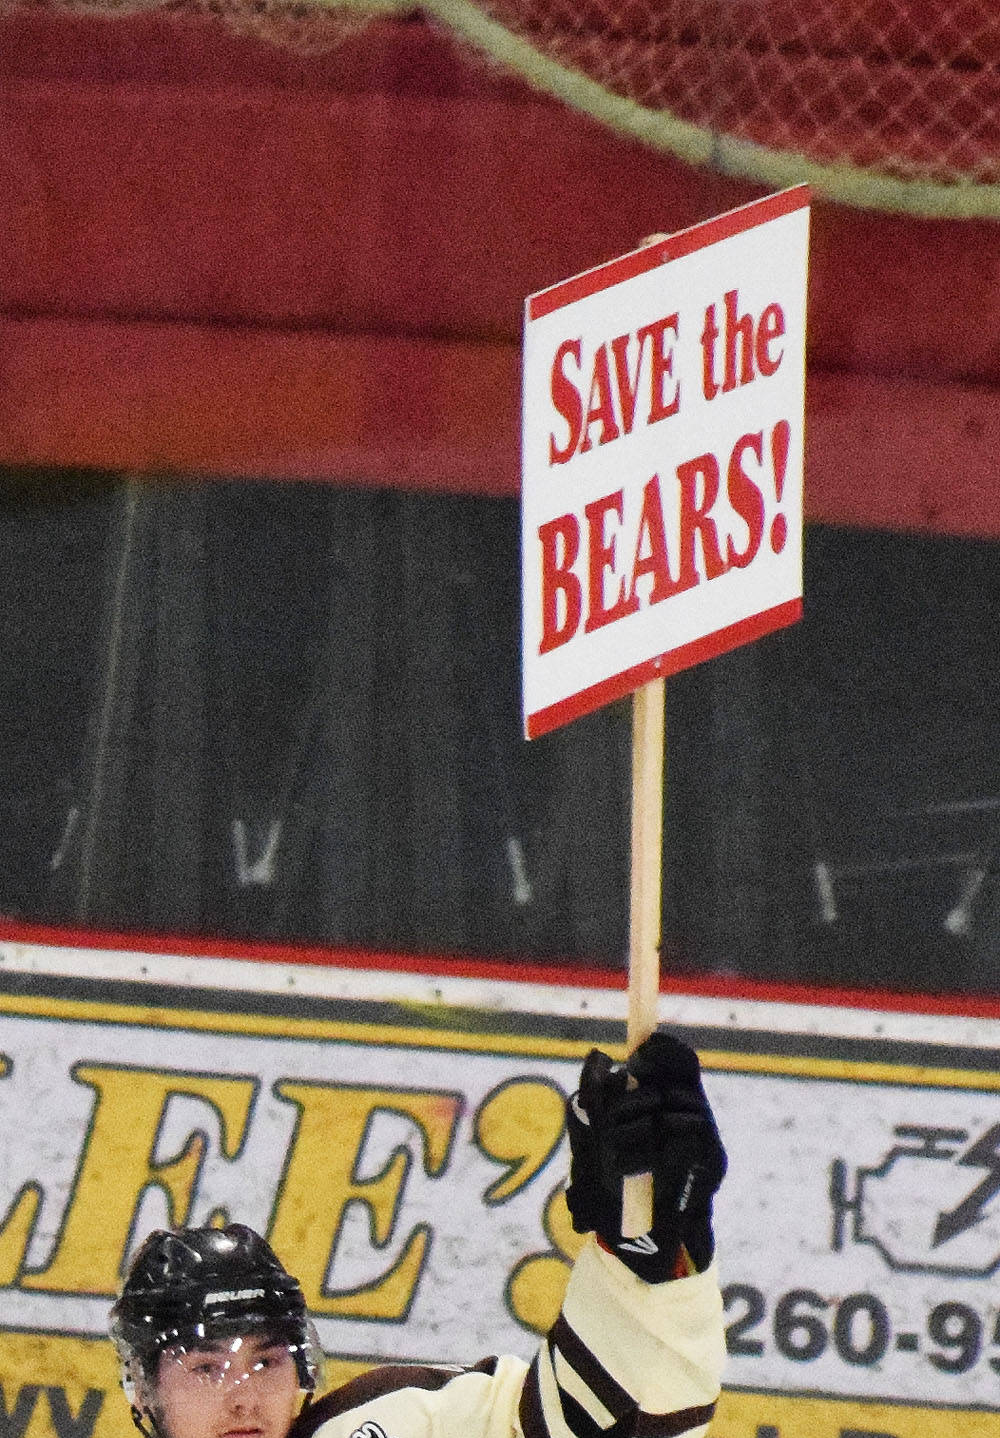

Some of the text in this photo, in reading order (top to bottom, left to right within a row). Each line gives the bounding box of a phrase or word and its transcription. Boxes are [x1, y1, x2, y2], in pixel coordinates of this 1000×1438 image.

[549, 289, 785, 466] SAVE the
[538, 419, 791, 655] BEARS!
[719, 1283, 1000, 1375] 260-9
